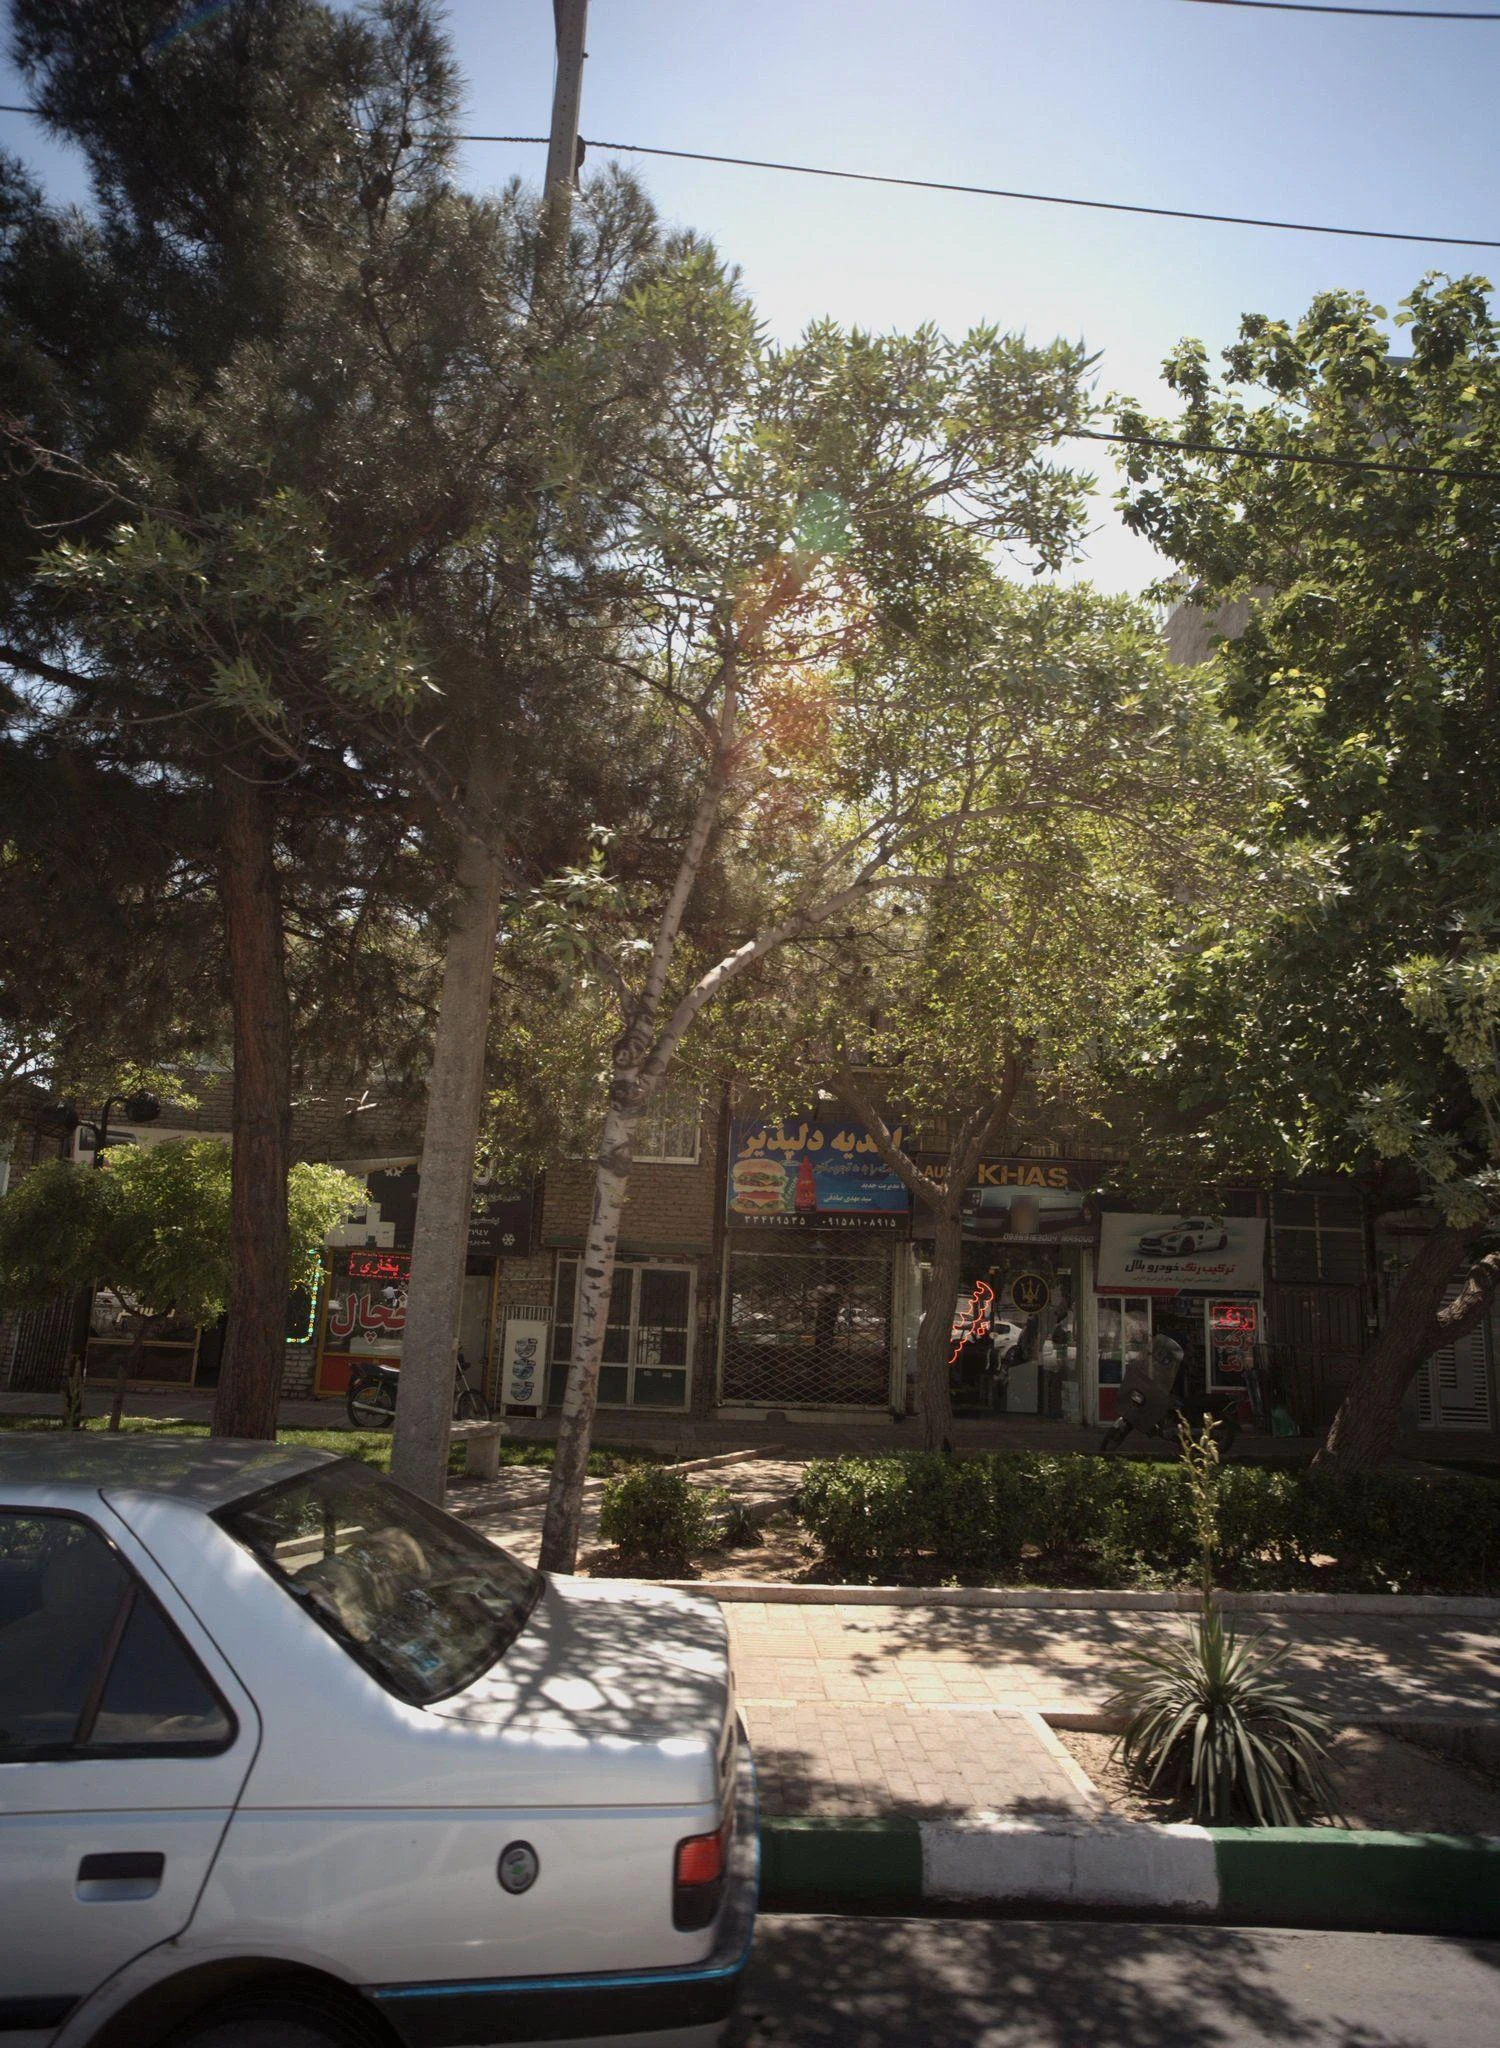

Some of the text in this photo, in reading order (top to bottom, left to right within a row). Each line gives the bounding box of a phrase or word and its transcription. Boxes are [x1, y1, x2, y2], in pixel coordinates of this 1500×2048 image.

[737, 1121, 903, 1160] اذیه دلپذیر
[978, 1163, 1069, 1188] KHAS
[1125, 1259, 1237, 1275] ترکیب رنگ خودرو بلال
[329, 1292, 409, 1346] خچال
